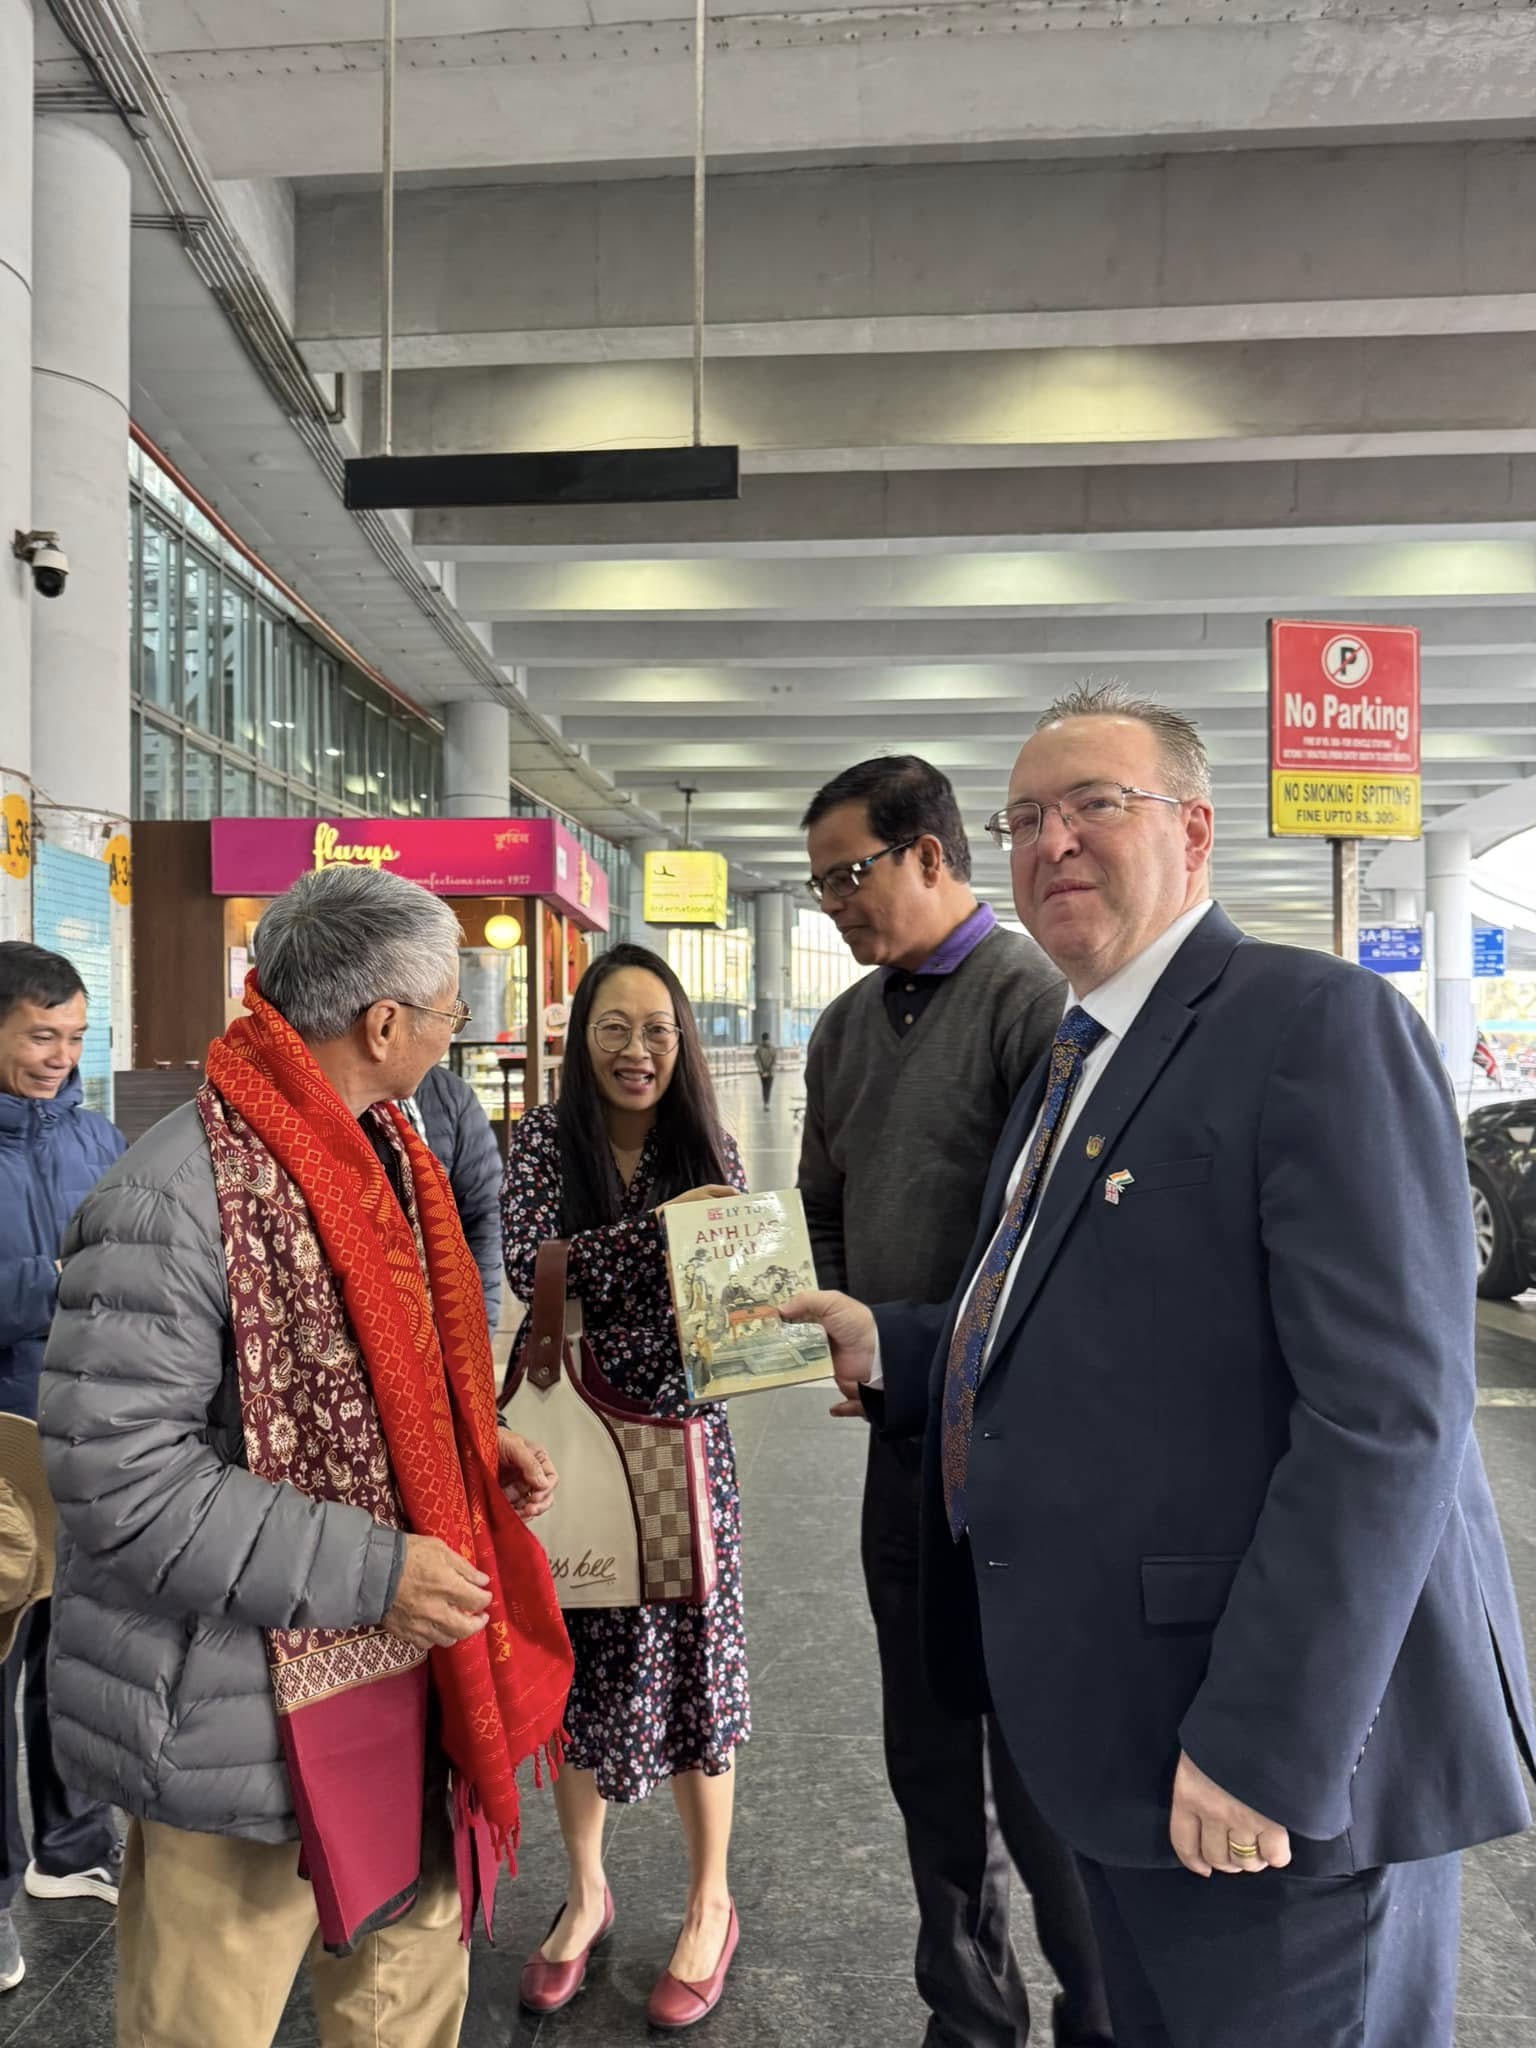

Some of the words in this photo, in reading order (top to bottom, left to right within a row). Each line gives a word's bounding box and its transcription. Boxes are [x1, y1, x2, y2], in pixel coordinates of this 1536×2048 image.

[1284, 692, 1317, 728] No
[1323, 693, 1409, 740] Parking
[1284, 783, 1300, 801] NO
[1303, 783, 1353, 803] SMOKING
[1362, 785, 1410, 804] SPITTING
[1297, 809, 1321, 822] FINE
[1324, 810, 1352, 823] UPTO
[313, 822, 400, 872] flurys
[412, 872, 472, 889] onfections
[475, 874, 504, 885] since
[696, 1226, 738, 1244] ANH
[572, 1548, 616, 1578] bee
